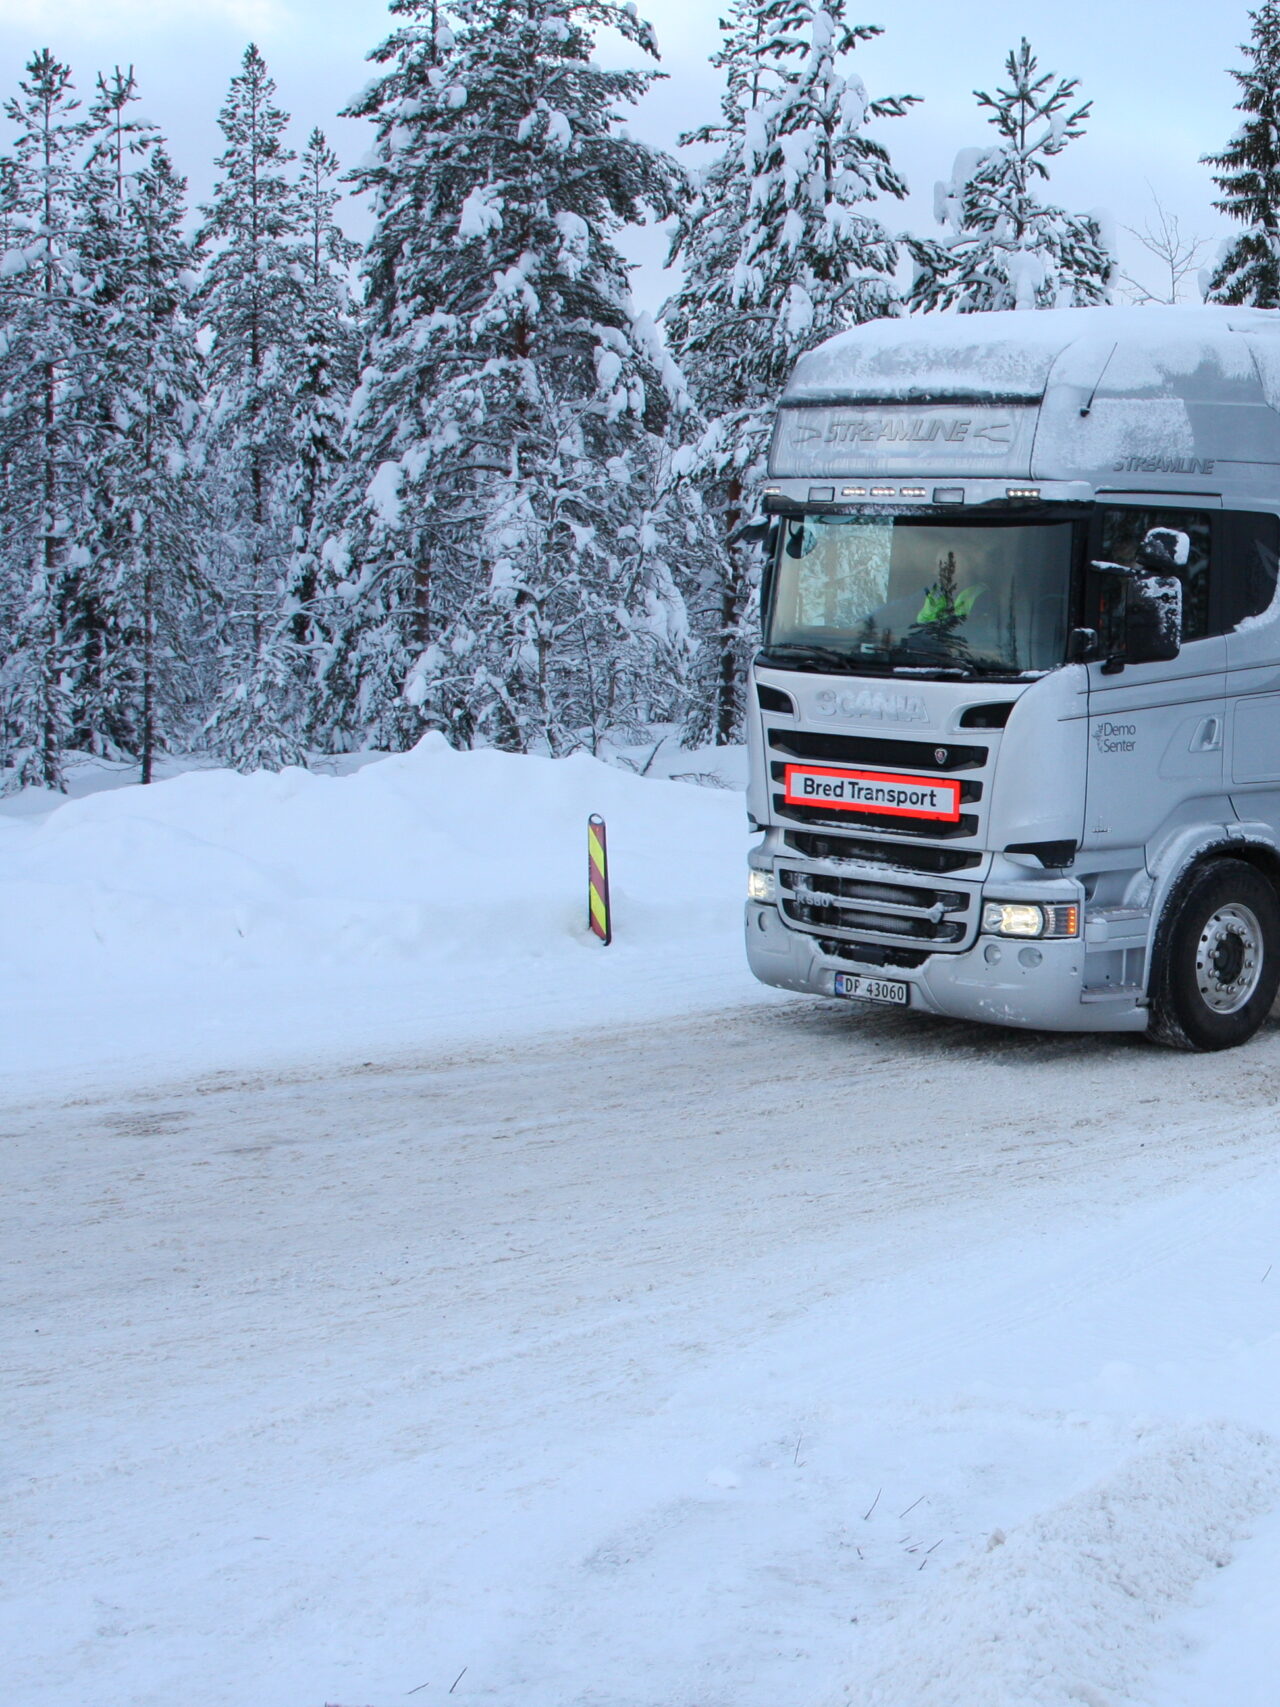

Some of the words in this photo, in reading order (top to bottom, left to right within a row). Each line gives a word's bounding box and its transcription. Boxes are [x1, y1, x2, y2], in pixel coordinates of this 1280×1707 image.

[824, 419, 972, 442] STREAMLINE
[1113, 454, 1215, 475] STREAMLINE
[1103, 722, 1136, 737] Demo
[1103, 738, 1136, 753] Senter
[803, 777, 844, 798] Bred
[848, 781, 937, 807] Transport
[866, 981, 905, 1001] 43060
